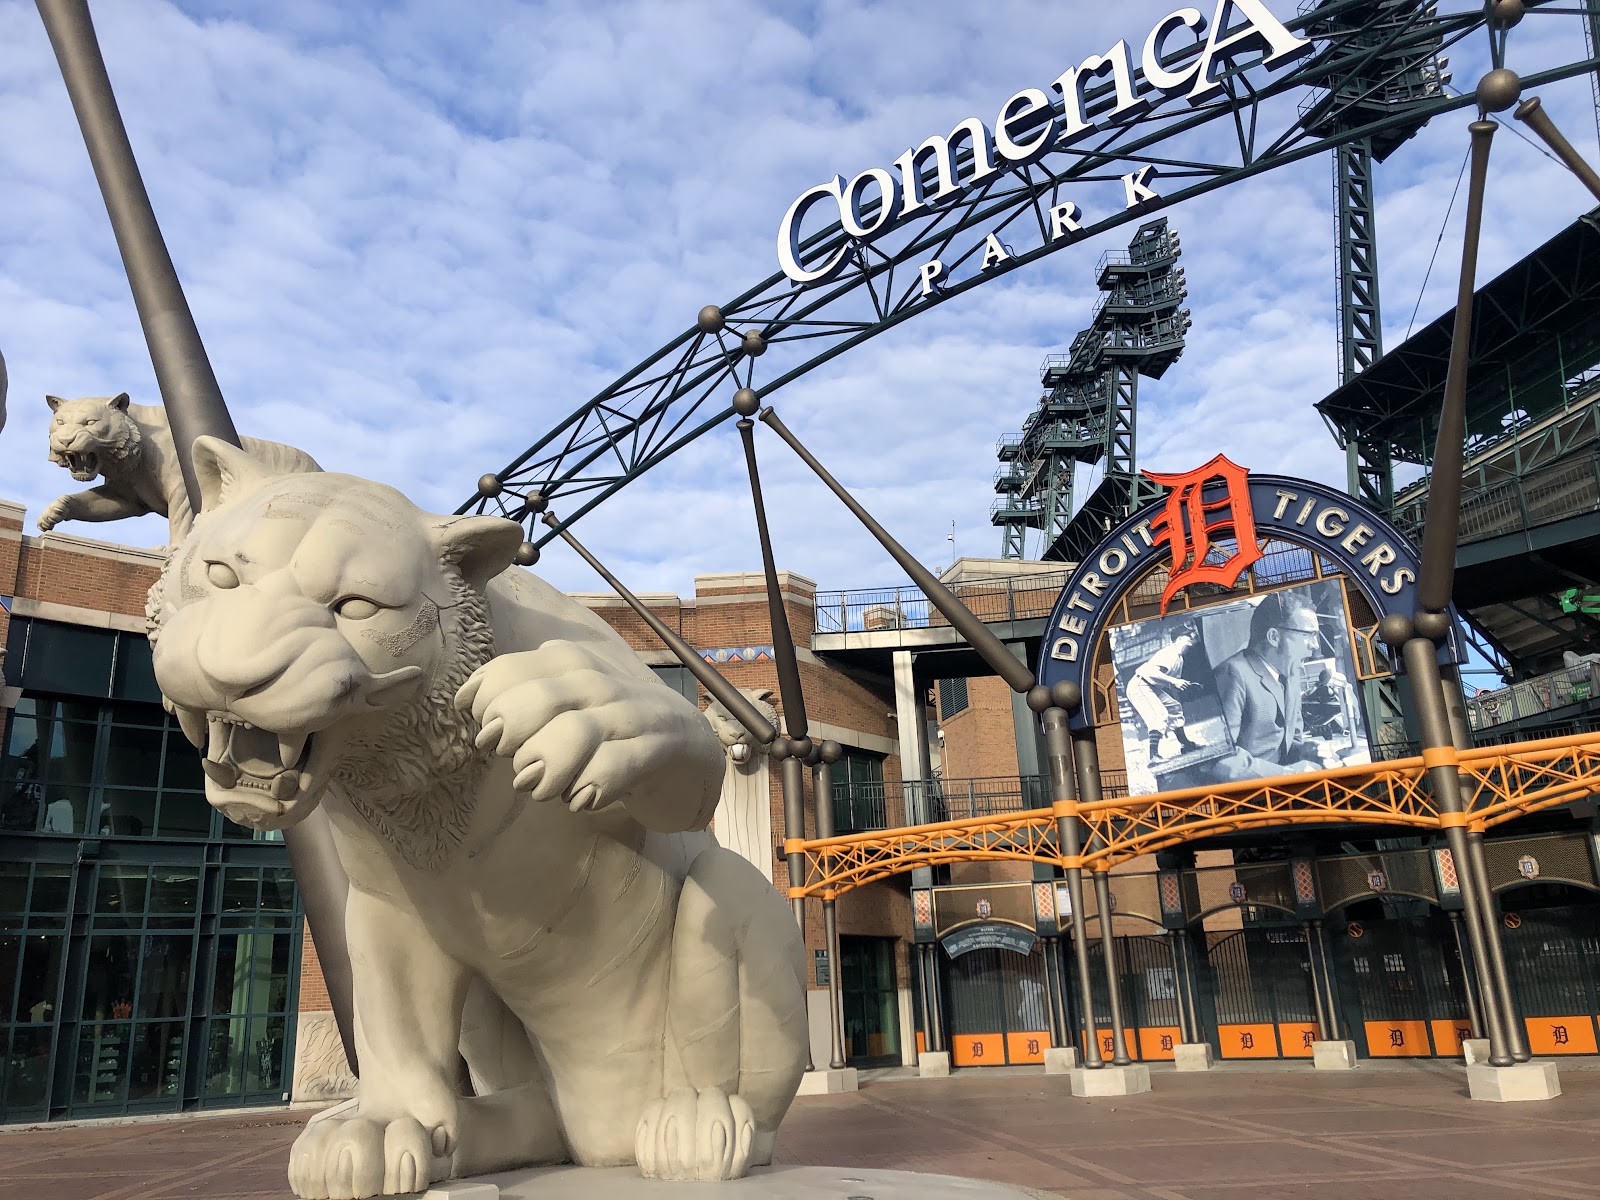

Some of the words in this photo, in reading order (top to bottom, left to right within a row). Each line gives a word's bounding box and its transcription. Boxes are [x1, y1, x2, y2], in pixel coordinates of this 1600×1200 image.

[919, 164, 1165, 301] PARK
[1050, 518, 1155, 662] DETROIT
[1272, 489, 1416, 595] TIGERS
[1140, 453, 1264, 616] D
